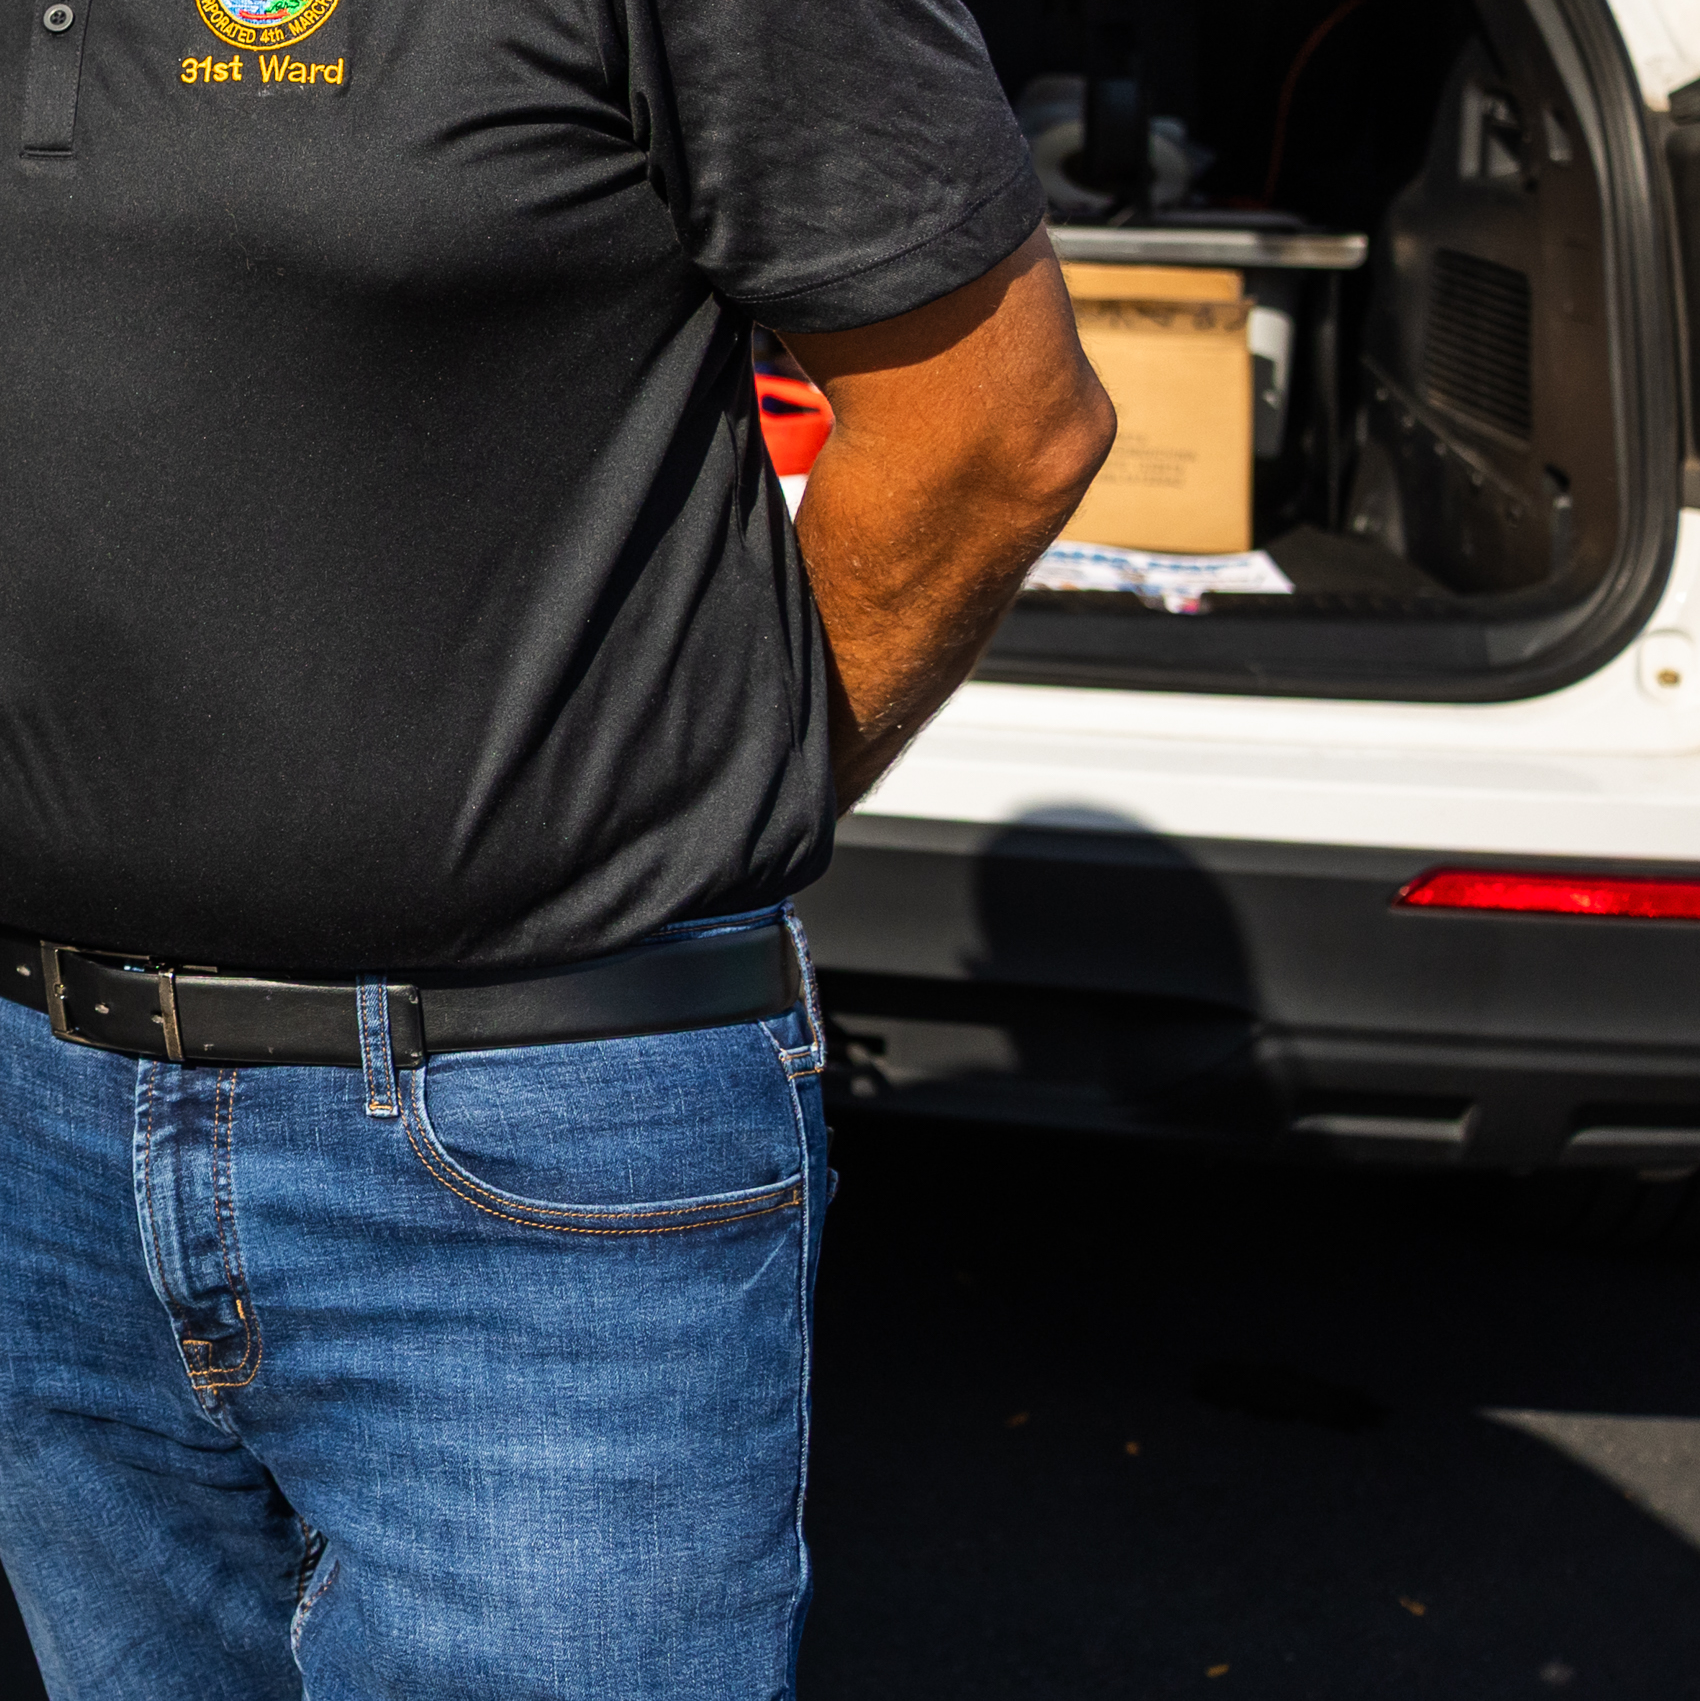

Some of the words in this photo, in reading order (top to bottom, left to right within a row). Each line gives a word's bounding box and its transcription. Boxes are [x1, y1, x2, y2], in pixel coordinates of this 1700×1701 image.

[259, 27, 285, 44] 4th
[180, 54, 243, 84] 31st
[258, 54, 344, 85] Ward
